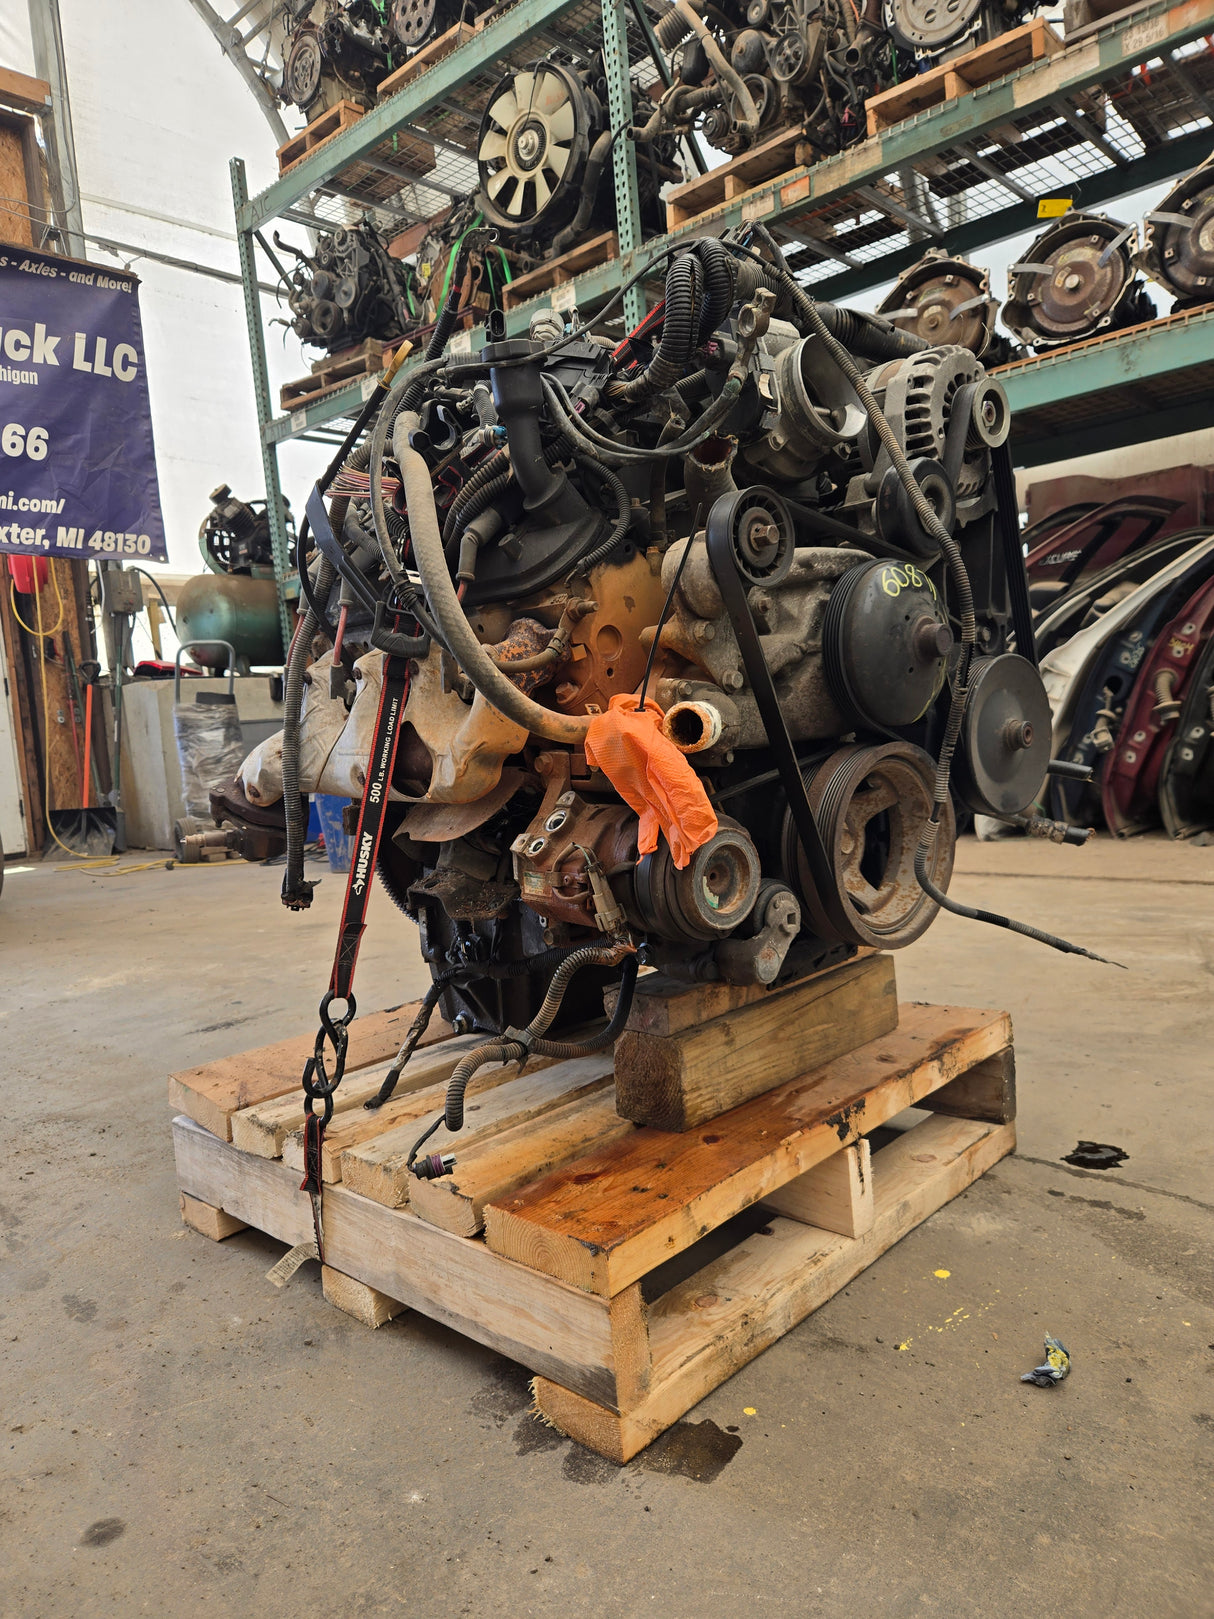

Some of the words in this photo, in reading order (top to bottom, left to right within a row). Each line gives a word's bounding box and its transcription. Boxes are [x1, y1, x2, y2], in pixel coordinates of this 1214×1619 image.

[19, 259, 58, 278] Axles
[69, 271, 95, 286] and
[97, 275, 133, 294] More!
[0, 322, 61, 366] ck
[73, 331, 139, 382] LLC
[1, 423, 49, 461] 66
[56, 526, 85, 549] MI
[88, 530, 152, 555] 48130
[387, 716, 395, 735] LOAD
[380, 736, 392, 769] WORKING
[378, 770, 386, 782] LB.
[370, 782, 383, 804] 500
[355, 831, 373, 879] HUSKY
